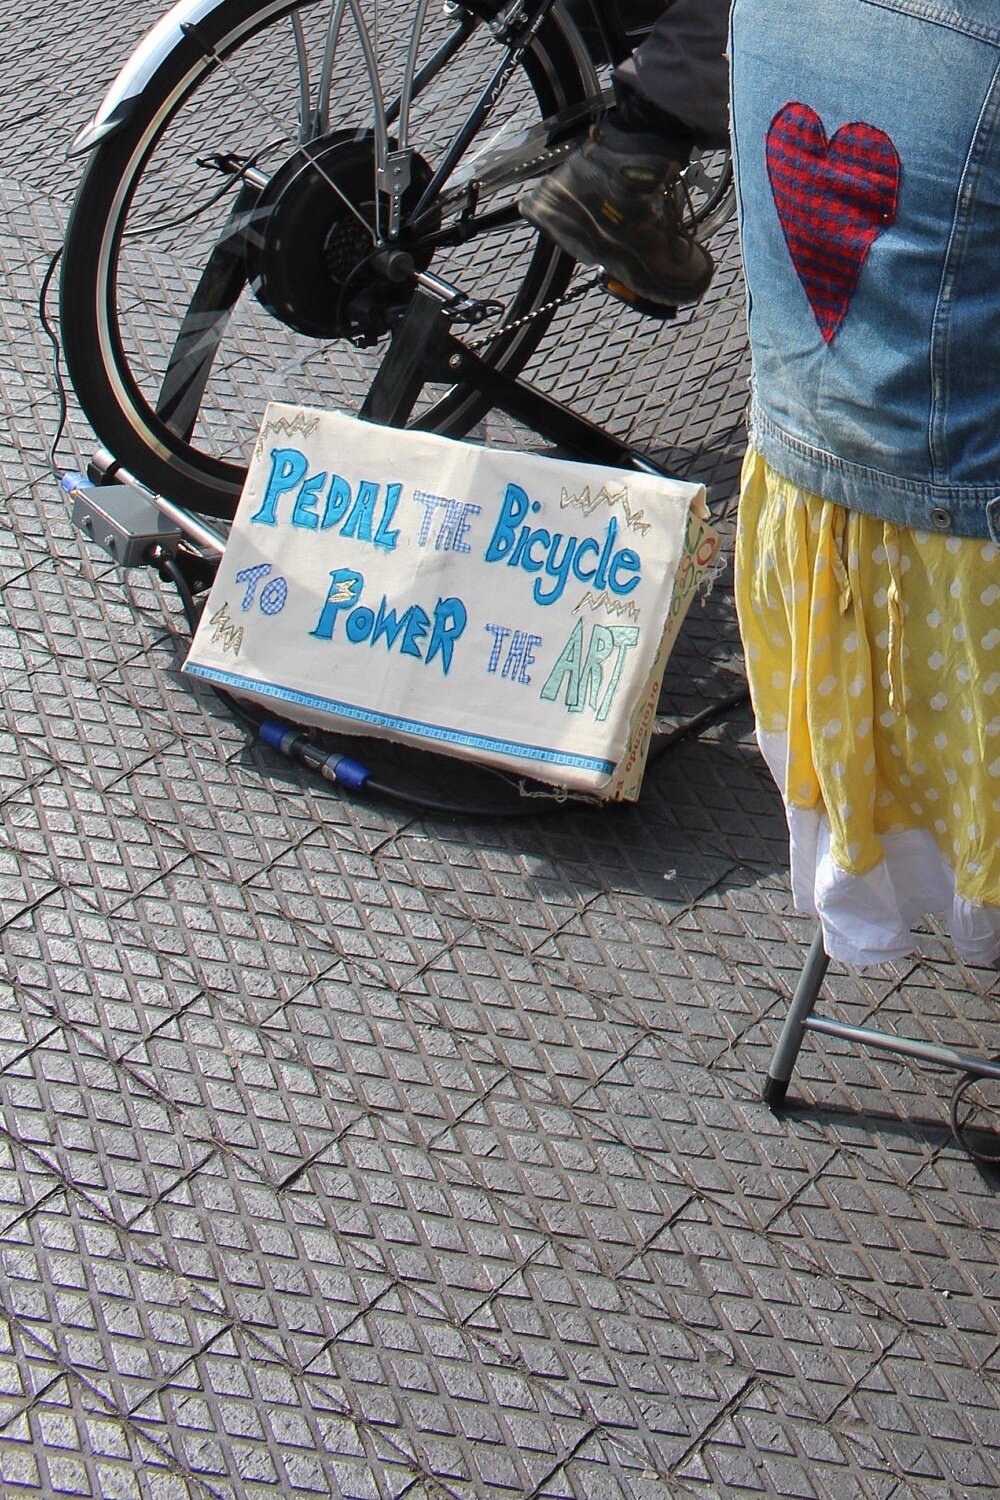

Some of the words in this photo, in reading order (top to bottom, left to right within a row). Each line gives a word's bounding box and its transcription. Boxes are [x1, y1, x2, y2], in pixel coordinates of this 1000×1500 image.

[484, 48, 525, 109] VIKING
[250, 448, 403, 550] PEDAL
[413, 489, 482, 554] THE
[485, 483, 641, 605] Bicycle
[235, 563, 287, 615] TO
[309, 568, 467, 677] POWER
[485, 622, 543, 684] THE
[539, 617, 640, 721] ART
